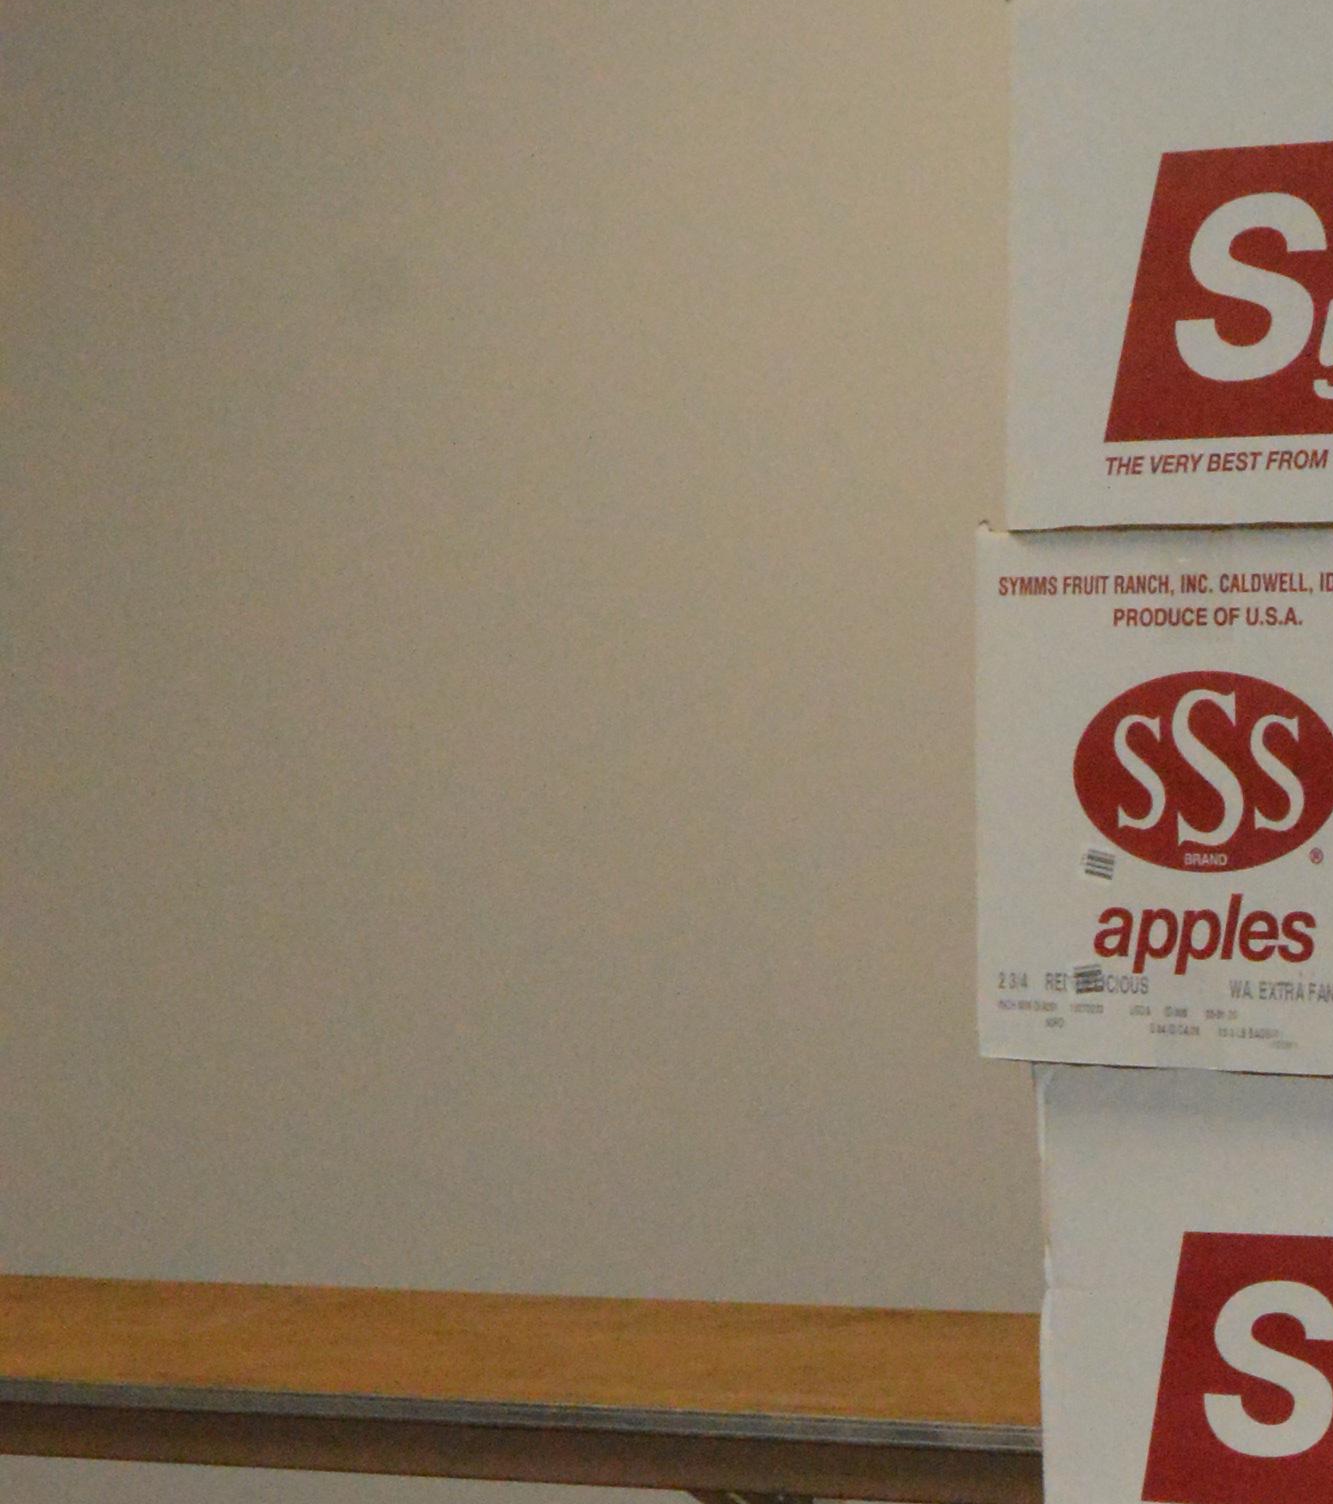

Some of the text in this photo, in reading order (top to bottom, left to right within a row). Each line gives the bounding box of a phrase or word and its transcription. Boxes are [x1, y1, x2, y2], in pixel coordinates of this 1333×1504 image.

[1105, 455, 1145, 476] THE
[1150, 453, 1204, 474] VERY
[1206, 451, 1263, 473] BEST
[1266, 448, 1330, 470] FROM
[1113, 688, 1305, 847] SSS
[1184, 852, 1228, 867] BRAND
[1093, 893, 1317, 975] apples
